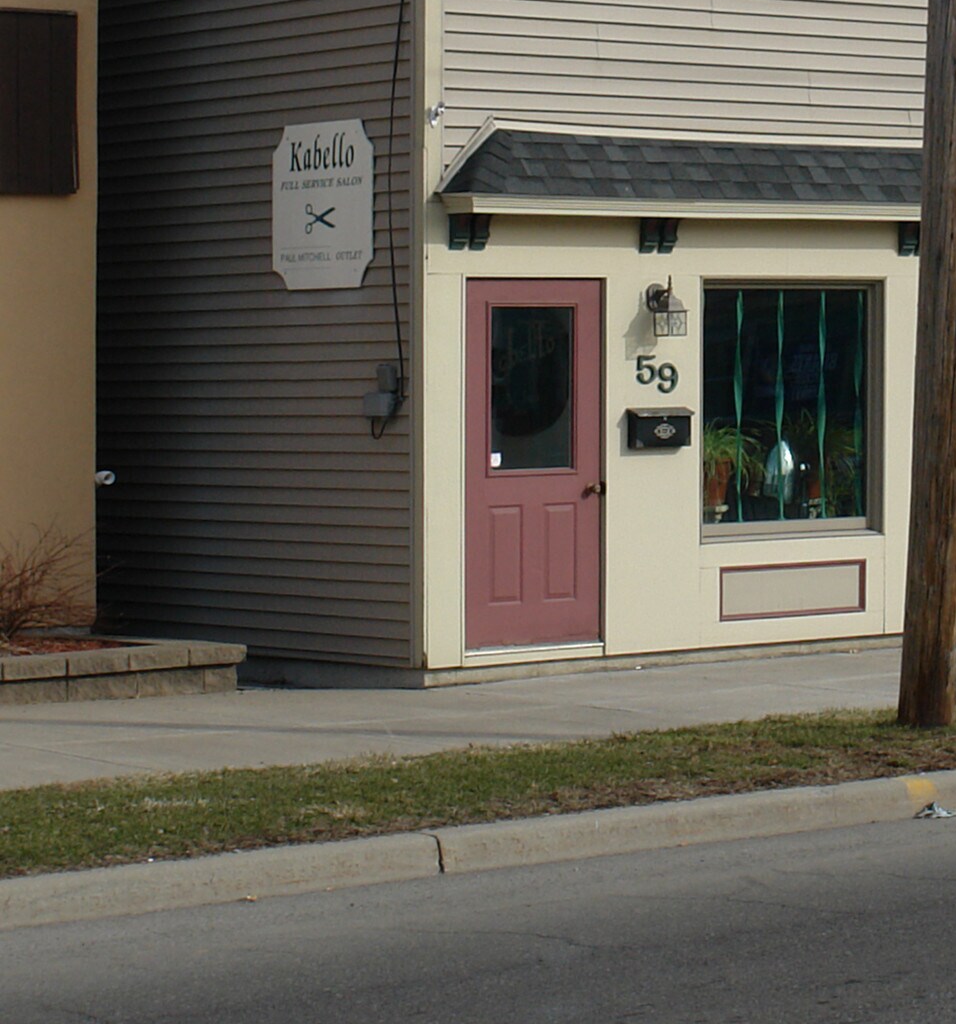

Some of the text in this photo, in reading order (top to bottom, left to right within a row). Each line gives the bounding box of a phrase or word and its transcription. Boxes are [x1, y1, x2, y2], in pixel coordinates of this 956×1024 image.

[289, 132, 354, 172] Kabello
[280, 176, 363, 191] FULL SERVICE SALON
[635, 354, 680, 394] 59
